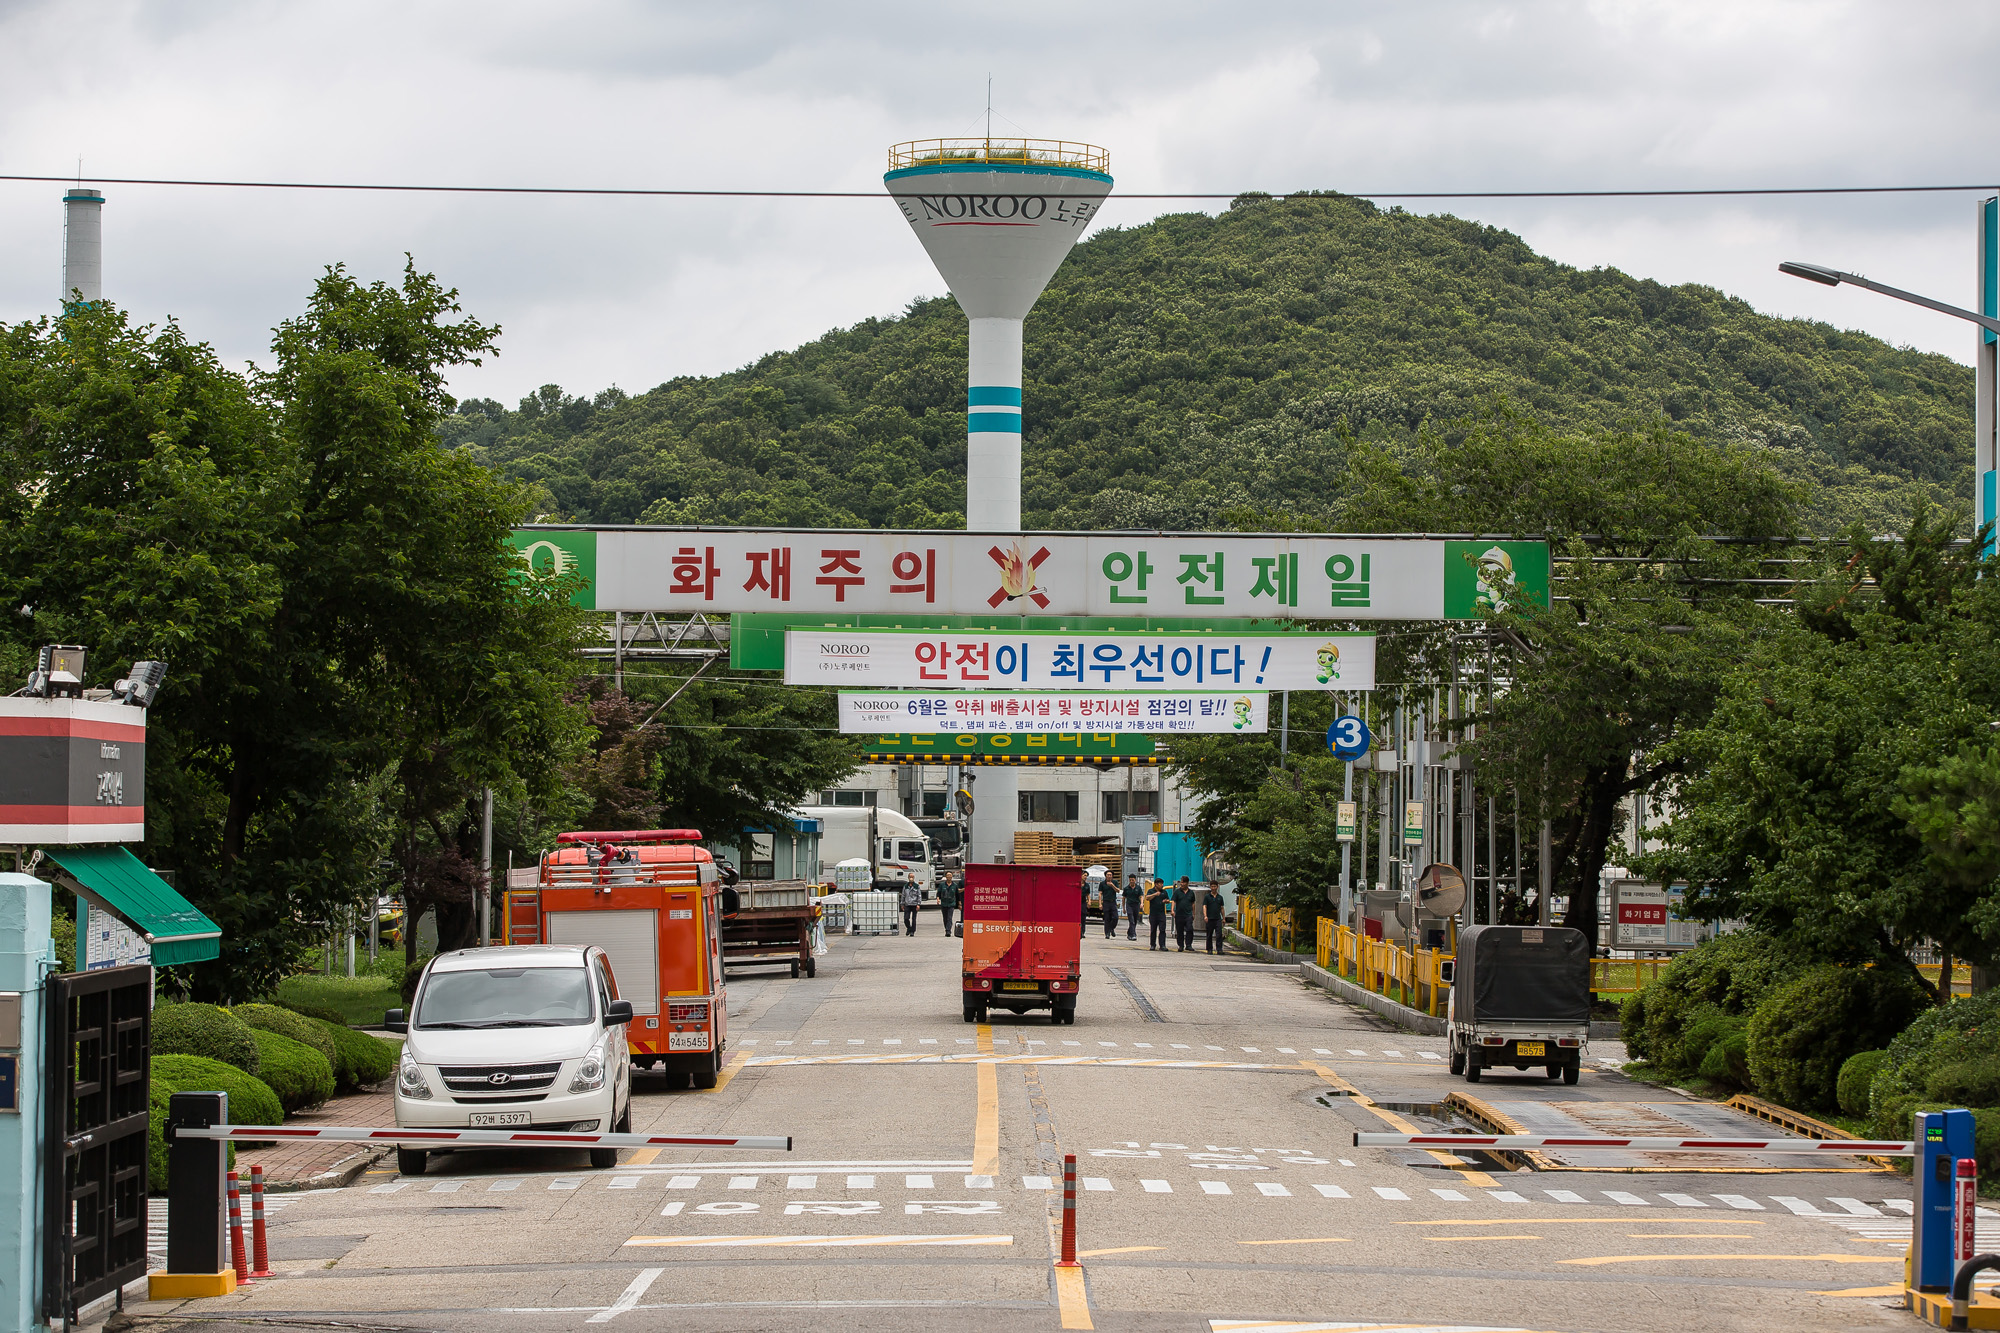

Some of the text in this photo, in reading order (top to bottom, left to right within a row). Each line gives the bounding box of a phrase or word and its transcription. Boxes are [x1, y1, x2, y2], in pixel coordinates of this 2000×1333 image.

[917, 195, 1047, 221] NOROO
[669, 546, 936, 603] 화재주의
[1102, 551, 1371, 608] 안전제일
[820, 643, 870, 655] NOROO
[915, 641, 1272, 685] 안전이 최우선이다!
[853, 700, 899, 711] NOROO
[907, 699, 1228, 716] 6월은 악취 배출시설 및 방지시설 점검의 달!!
[966, 720, 985, 730] 댐퍼
[1015, 720, 1033, 730] 댐퍼
[1037, 720, 1069, 730] on/off
[1073, 720, 1082, 730] 및
[1086, 720, 1123, 730] 방지시설
[1127, 720, 1164, 730] 가동상태
[1336, 718, 1362, 748] 3
[985, 925, 1054, 934] SERVEONE STORE
[475, 1113, 525, 1125] 92버 5397
